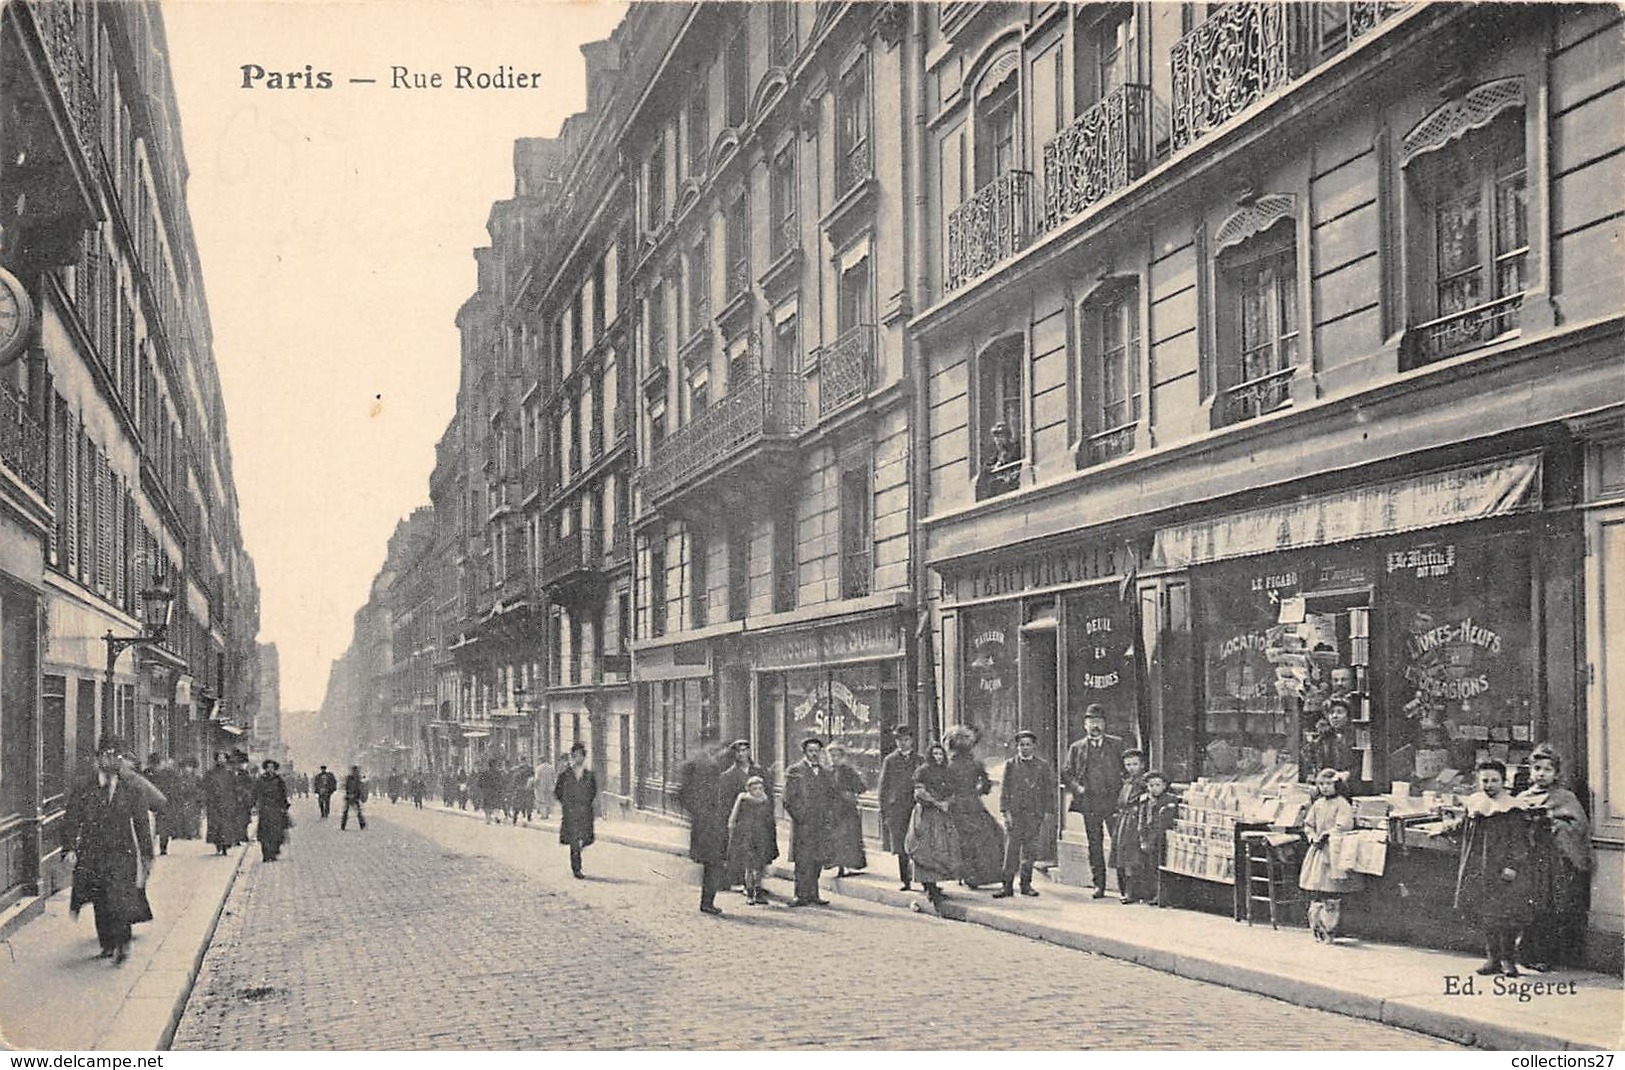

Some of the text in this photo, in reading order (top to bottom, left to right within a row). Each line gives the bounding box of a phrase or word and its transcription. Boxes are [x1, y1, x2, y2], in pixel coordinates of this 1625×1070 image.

[1252, 572, 1298, 591] LE FIGARO
[1086, 617, 1112, 635] DEUIL
[974, 630, 1005, 648] TAILLEUR
[1220, 631, 1269, 660] LOCATIO
[1095, 647, 1107, 660] EN
[980, 678, 1002, 692] FAÇON
